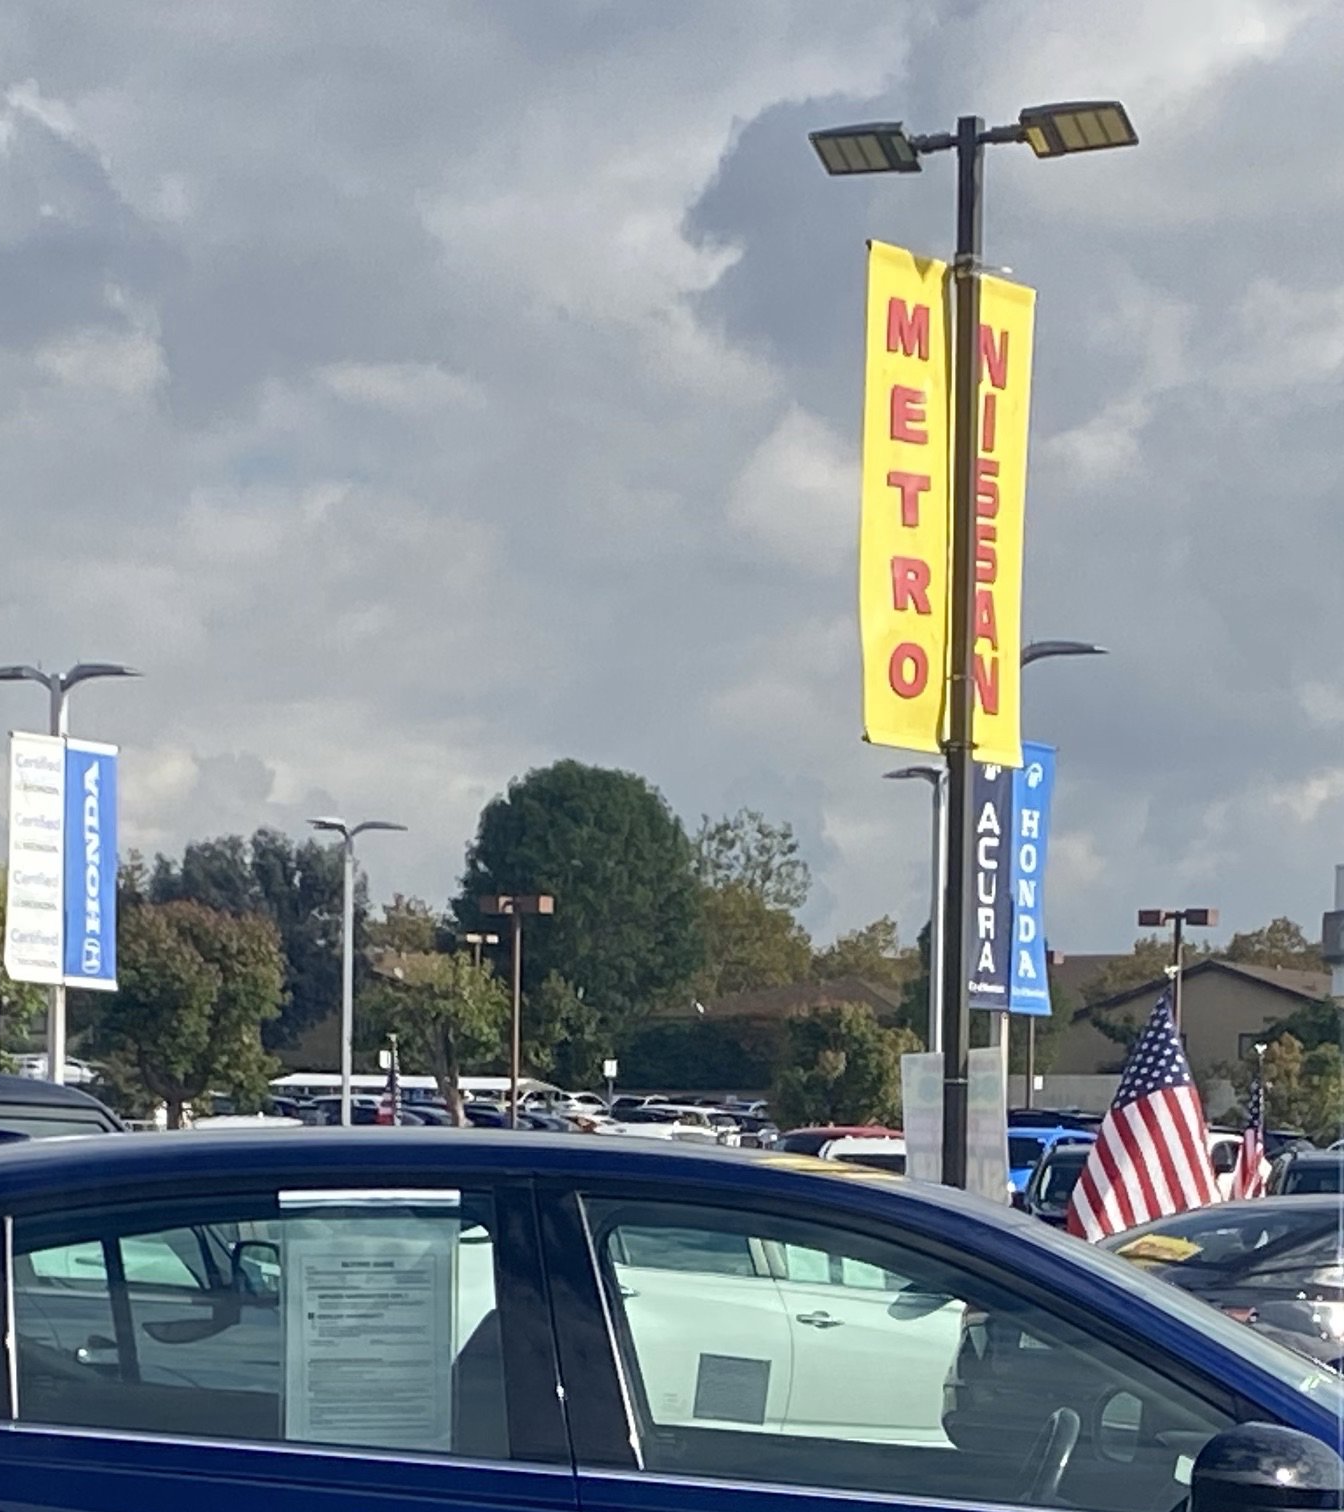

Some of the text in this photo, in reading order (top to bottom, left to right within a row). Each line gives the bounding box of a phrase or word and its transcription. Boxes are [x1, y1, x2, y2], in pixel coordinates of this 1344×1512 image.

[887, 296, 932, 699] METRO
[974, 323, 1009, 715] NISSAN
[83, 759, 101, 935] HONDA
[976, 801, 1001, 974] ACURA
[1017, 808, 1041, 978] HONDA
